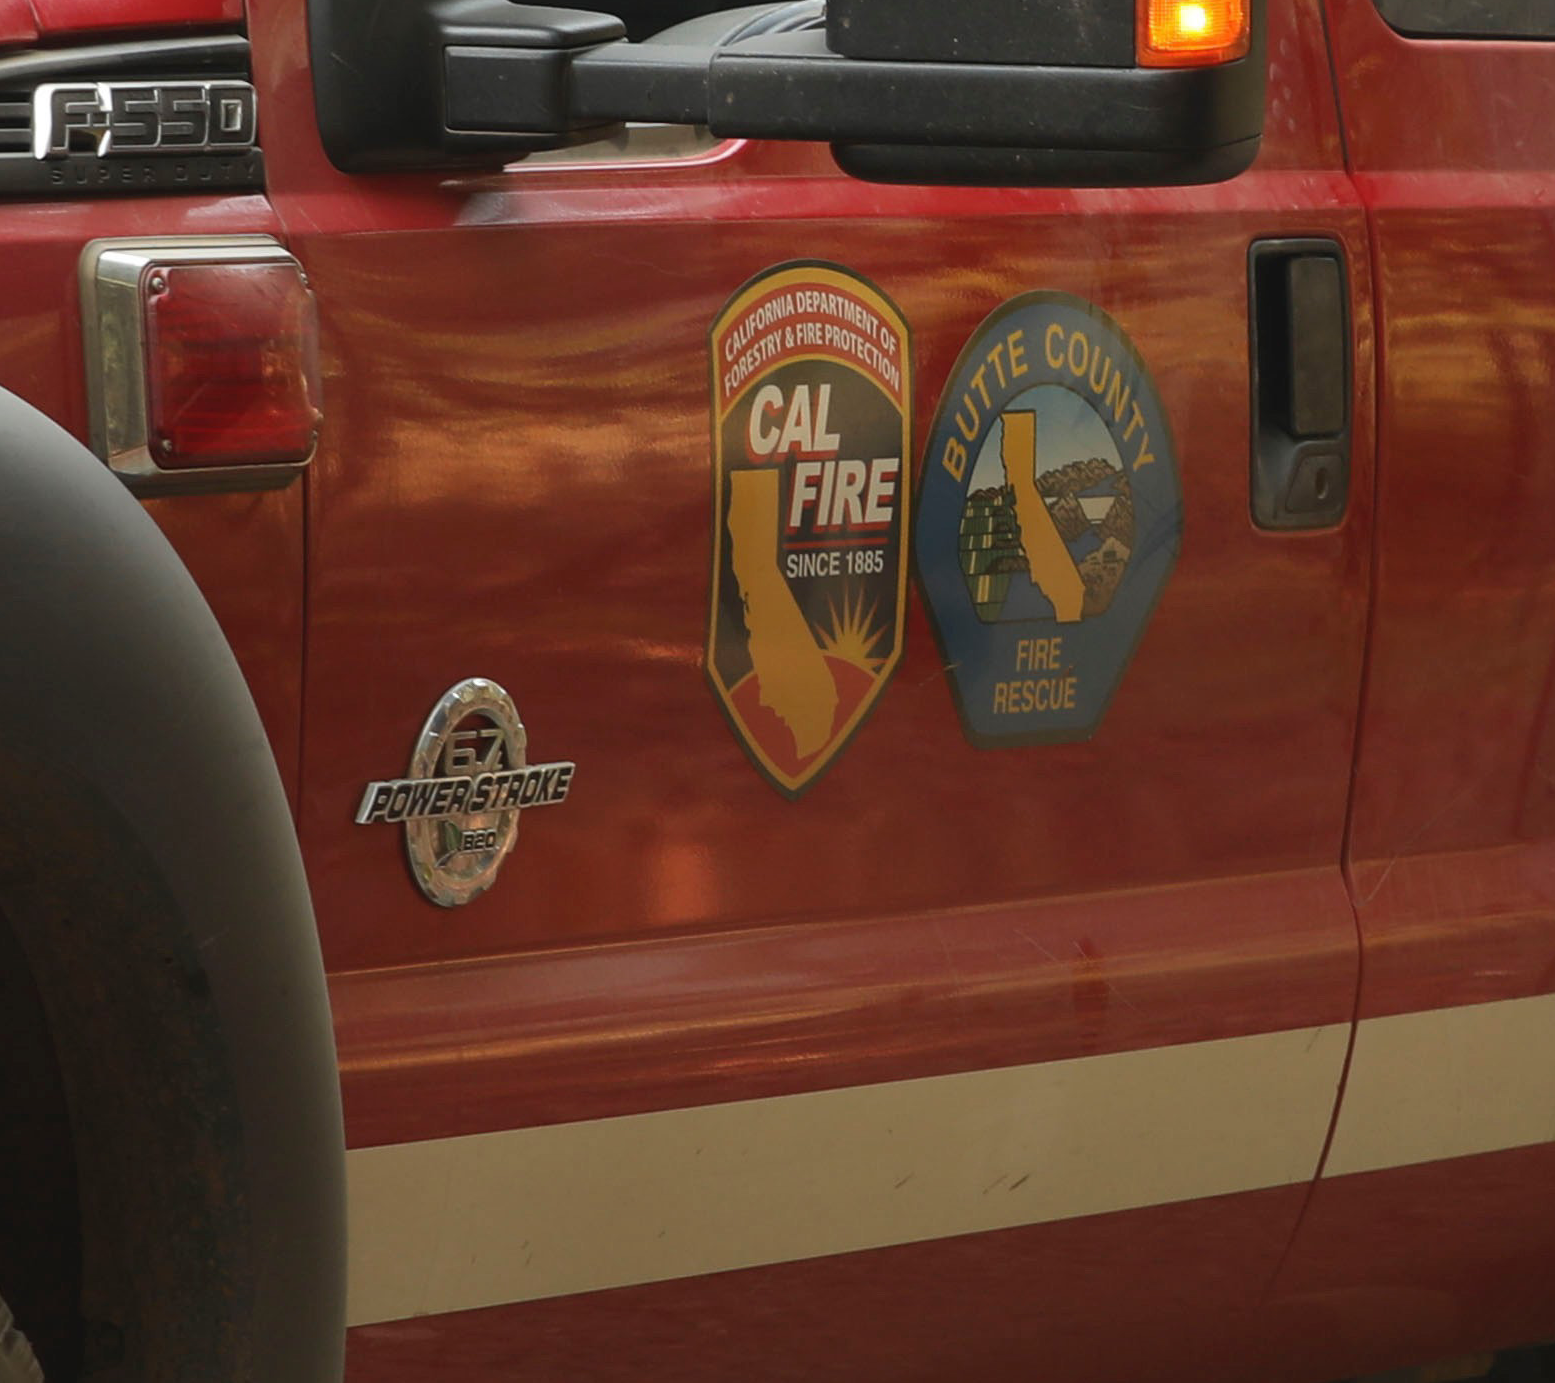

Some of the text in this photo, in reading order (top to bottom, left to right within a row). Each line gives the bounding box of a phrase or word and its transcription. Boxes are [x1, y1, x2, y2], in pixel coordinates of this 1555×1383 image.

[50, 162, 259, 186] SUPER DUTY
[724, 322, 900, 398] FORESTRY & FIRE PROTECTION
[725, 290, 898, 362] CALIFORNIA DEPARTMENT OF
[747, 383, 841, 457] CAL
[941, 322, 1155, 483] BUTTE COUNTY
[789, 457, 900, 528] FIRE
[786, 549, 885, 579] SINCE 1885
[1016, 637, 1063, 672] FIRE
[993, 677, 1077, 715] RESCUE
